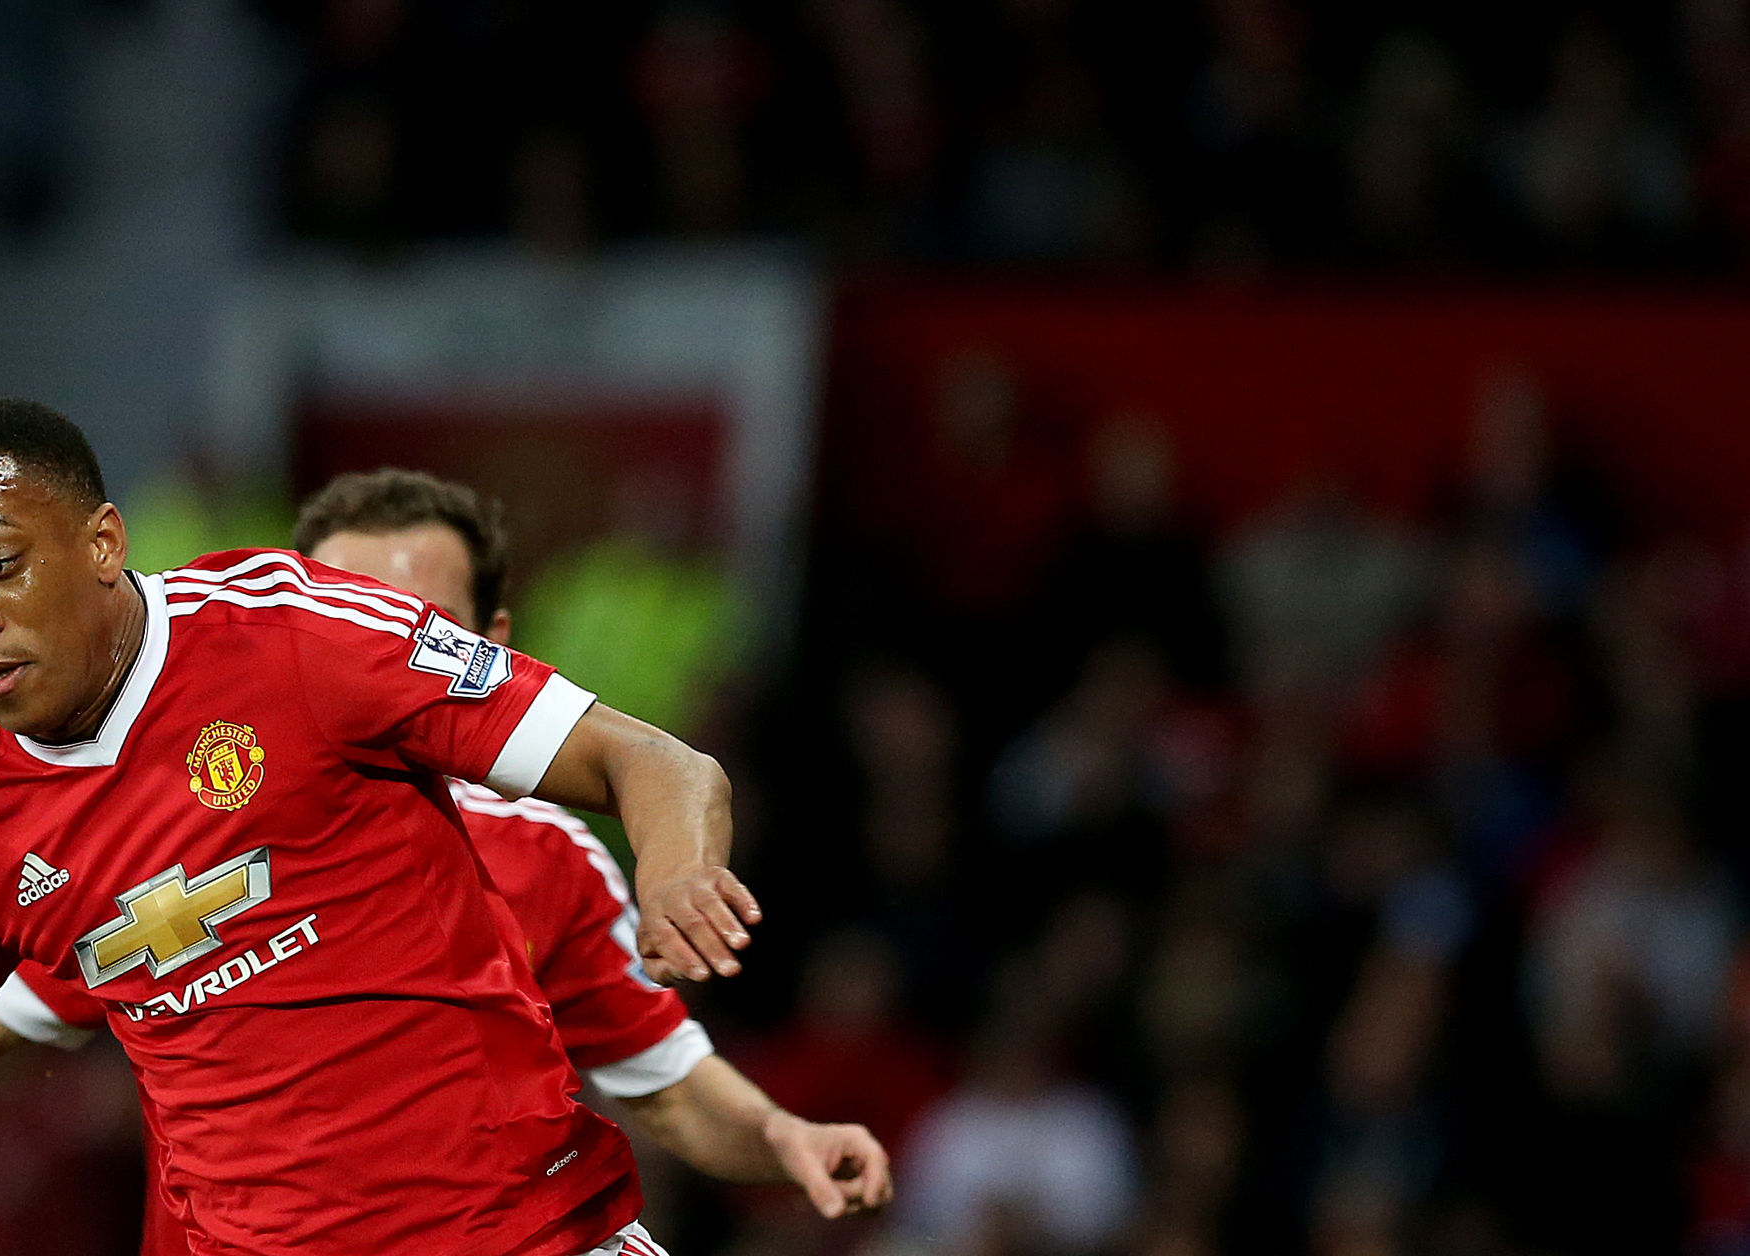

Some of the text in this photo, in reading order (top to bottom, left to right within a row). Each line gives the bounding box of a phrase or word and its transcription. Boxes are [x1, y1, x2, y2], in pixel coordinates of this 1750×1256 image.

[193, 726, 251, 769] MANCHESTER
[212, 779, 256, 806] UNITED
[17, 868, 70, 907] adidas
